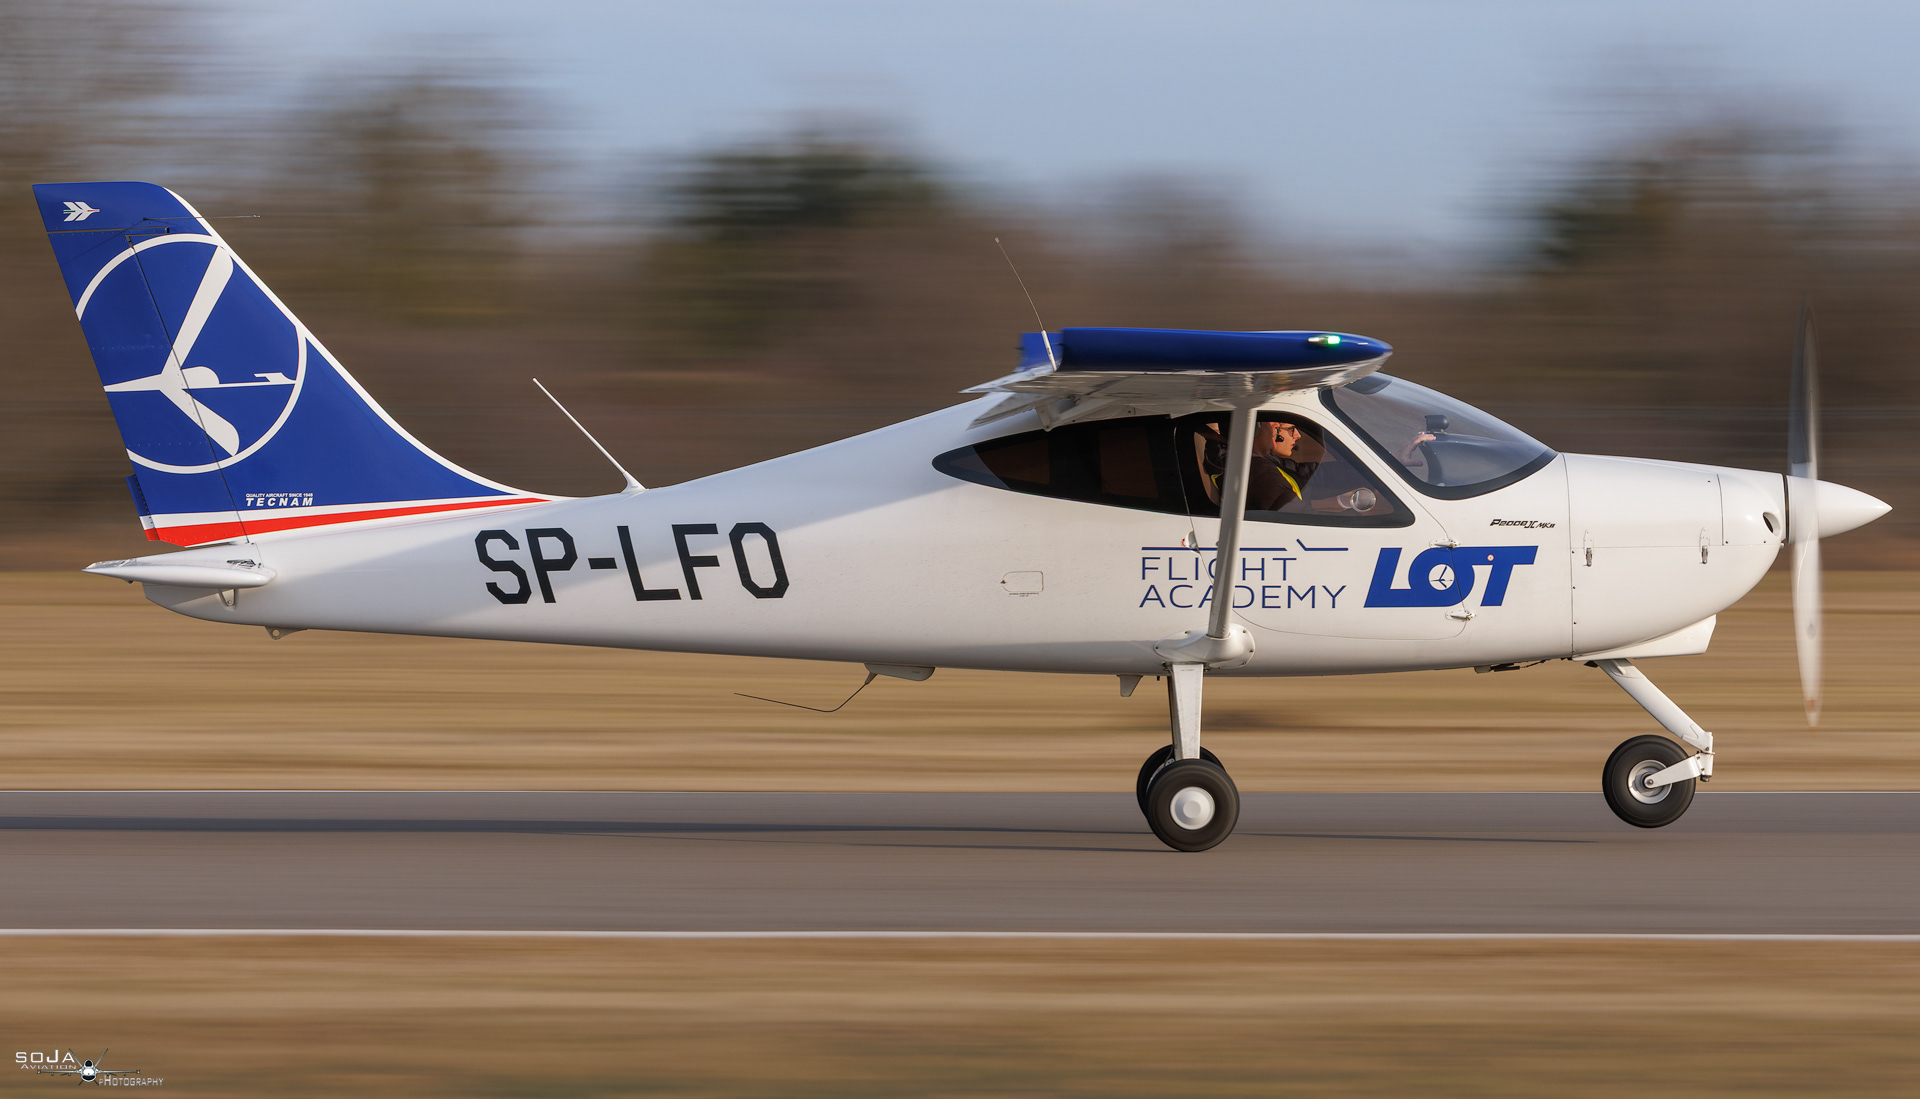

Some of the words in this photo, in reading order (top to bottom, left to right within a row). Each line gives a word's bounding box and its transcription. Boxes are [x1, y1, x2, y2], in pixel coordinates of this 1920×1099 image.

[245, 497, 313, 507] TECNAM
[474, 521, 790, 605] SP-LFO
[1363, 545, 1539, 608] LOT
[1138, 584, 1348, 609] ACADEMY
